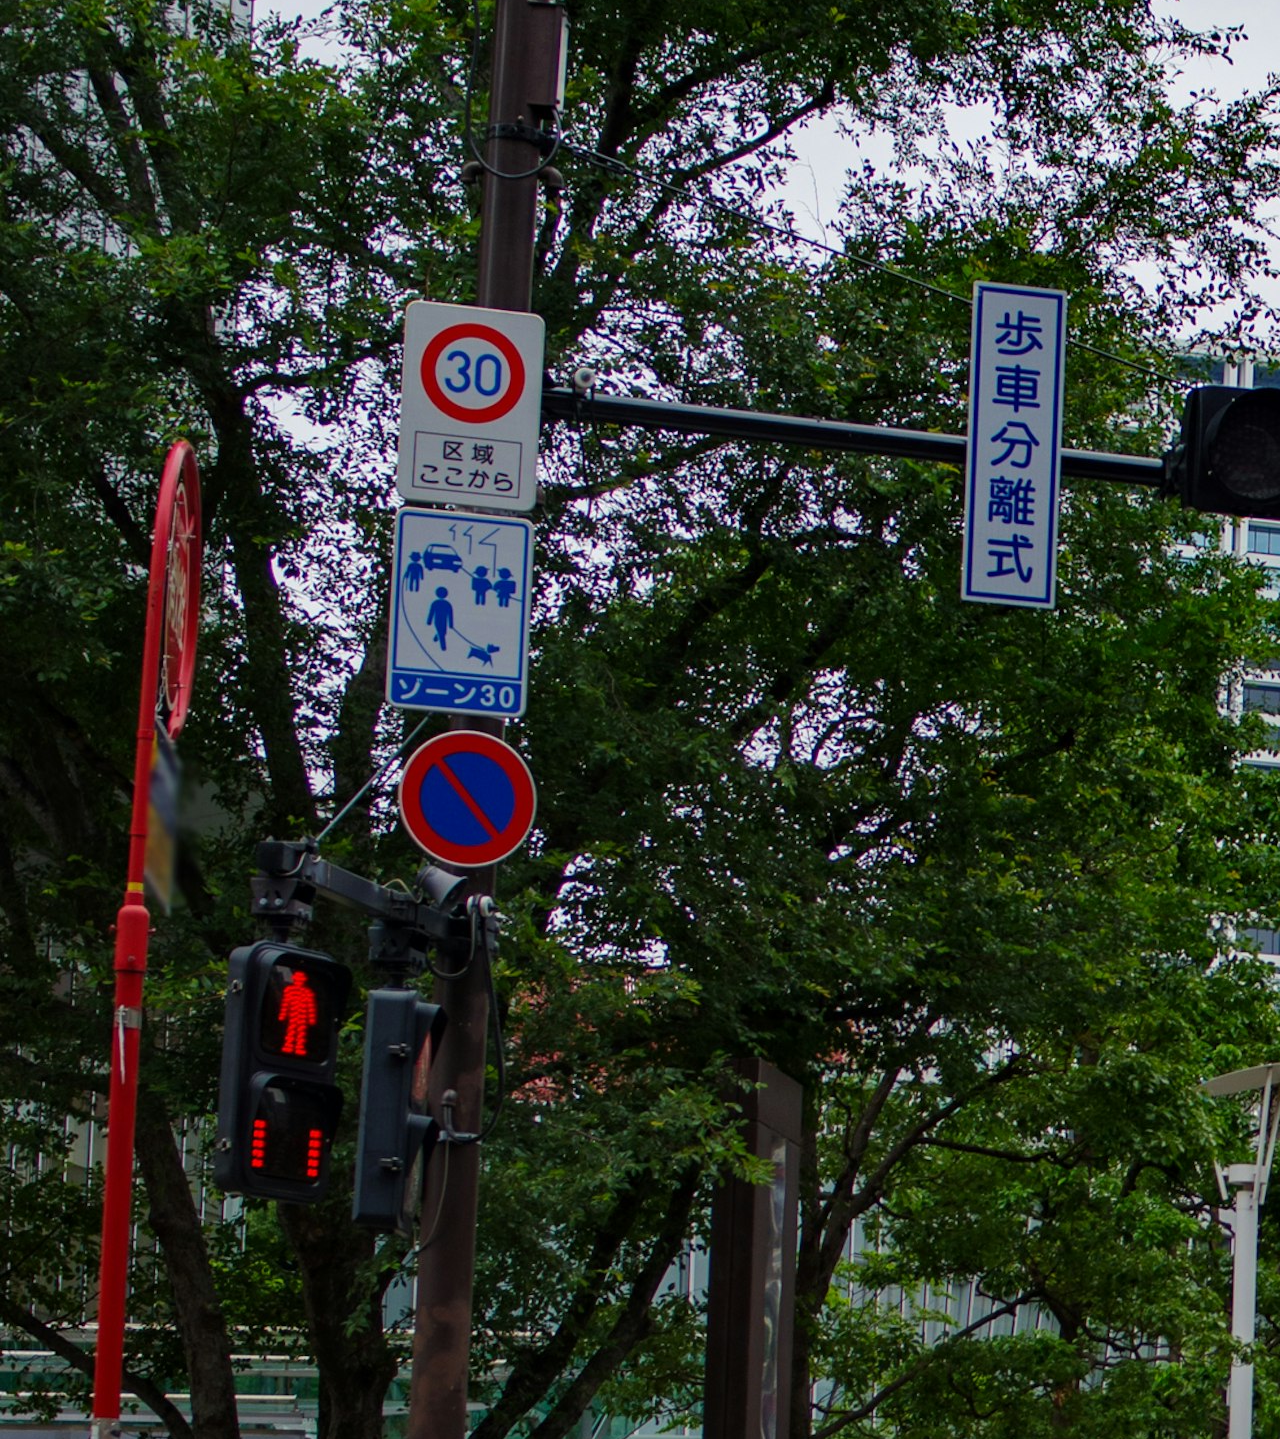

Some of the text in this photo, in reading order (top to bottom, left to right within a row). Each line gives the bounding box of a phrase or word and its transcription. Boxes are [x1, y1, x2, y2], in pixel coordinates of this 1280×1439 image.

[444, 350, 502, 397] 30
[443, 441, 494, 465] 区域
[987, 311, 1043, 583] 歩車分離式
[420, 465, 513, 492] ここから
[399, 677, 515, 709] ゾーン30
